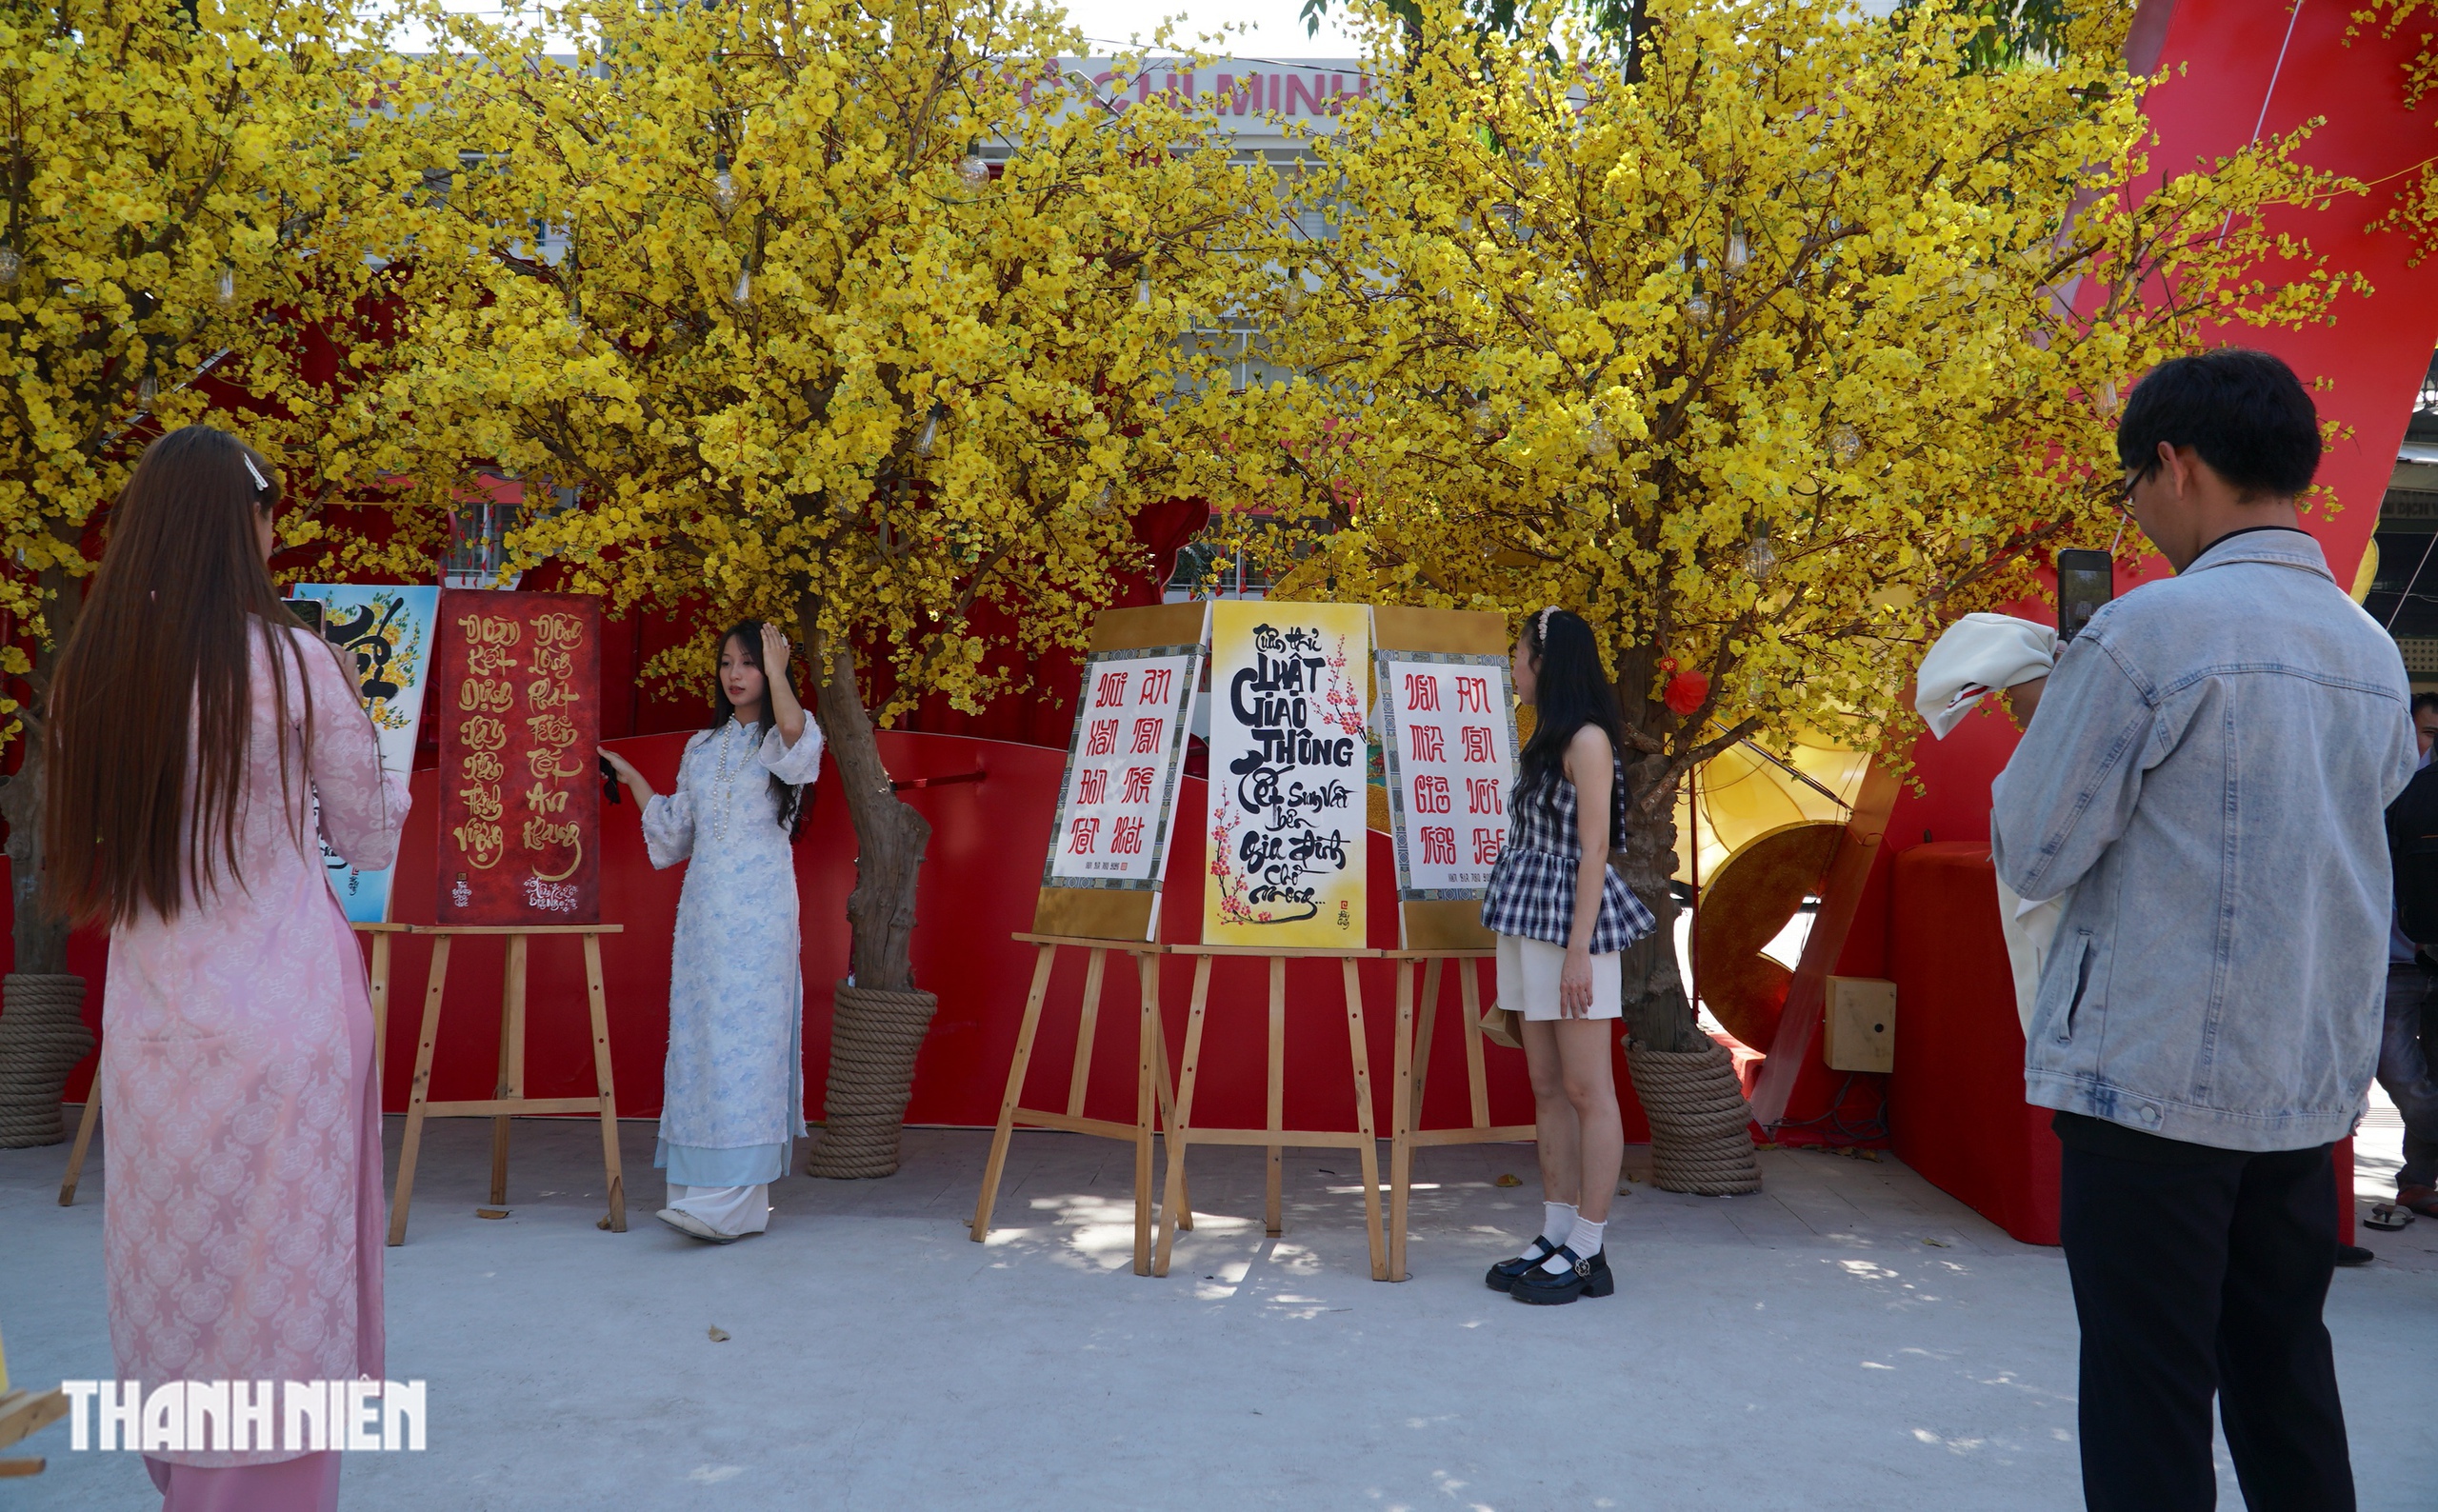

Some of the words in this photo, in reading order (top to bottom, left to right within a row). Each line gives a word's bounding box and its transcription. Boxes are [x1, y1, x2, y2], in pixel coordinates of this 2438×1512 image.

[1216, 73, 1370, 116] MINH
[467, 644, 518, 676] Kết
[1249, 728, 1354, 767] THÔNG
[527, 748, 584, 786] Tết
